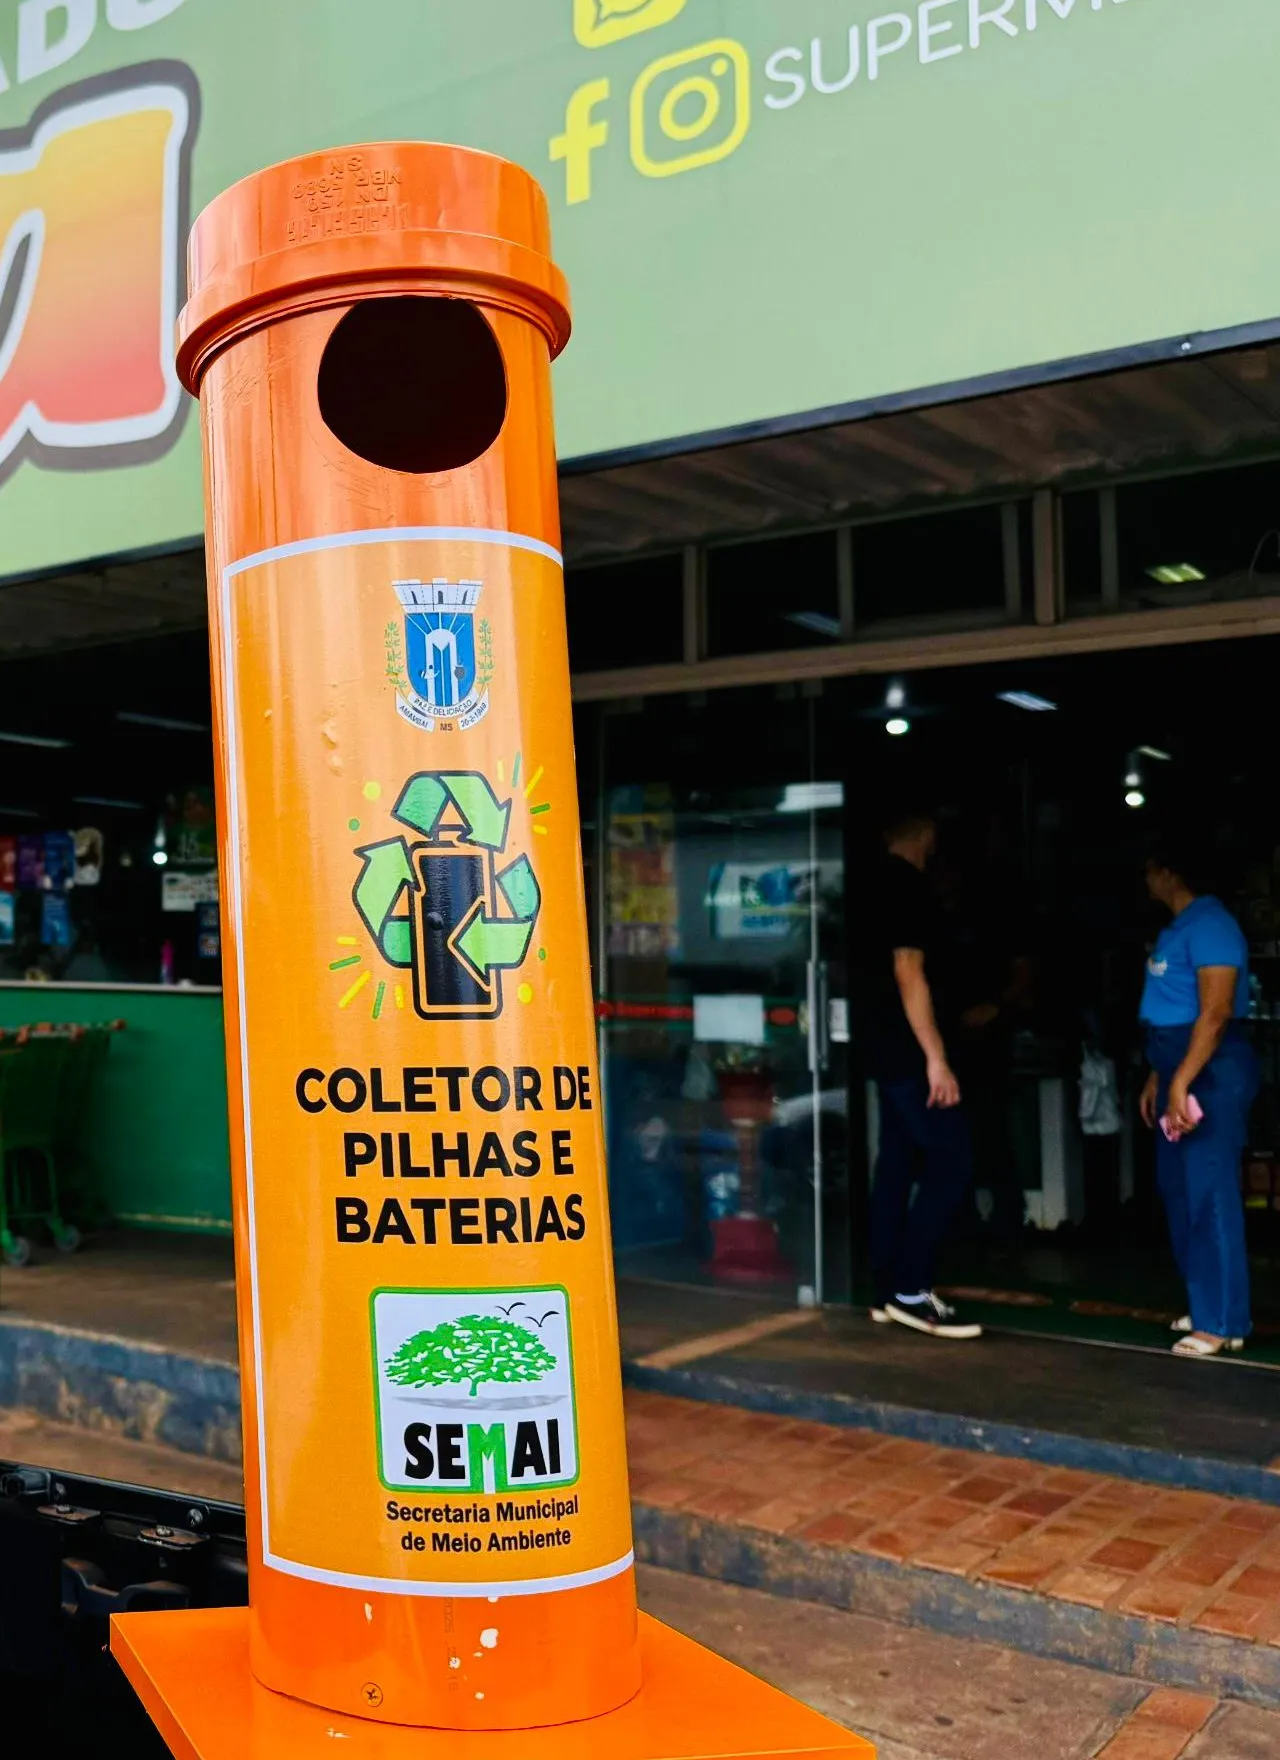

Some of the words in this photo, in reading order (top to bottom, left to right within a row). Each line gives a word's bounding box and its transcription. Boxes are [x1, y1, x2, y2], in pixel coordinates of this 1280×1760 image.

[440, 722, 454, 732] MS
[295, 1065, 544, 1114] COLETOR
[552, 1065, 592, 1111] DE
[343, 1130, 541, 1178] PILHAS
[551, 1130, 574, 1176] E
[335, 1193, 586, 1245] BATERIAS
[403, 1418, 561, 1492] SEMAI
[385, 1500, 490, 1523] Secretaria
[496, 1494, 579, 1522] Municipal
[401, 1530, 426, 1551] de
[431, 1532, 482, 1553] Meio
[487, 1527, 571, 1552] Ambiente
